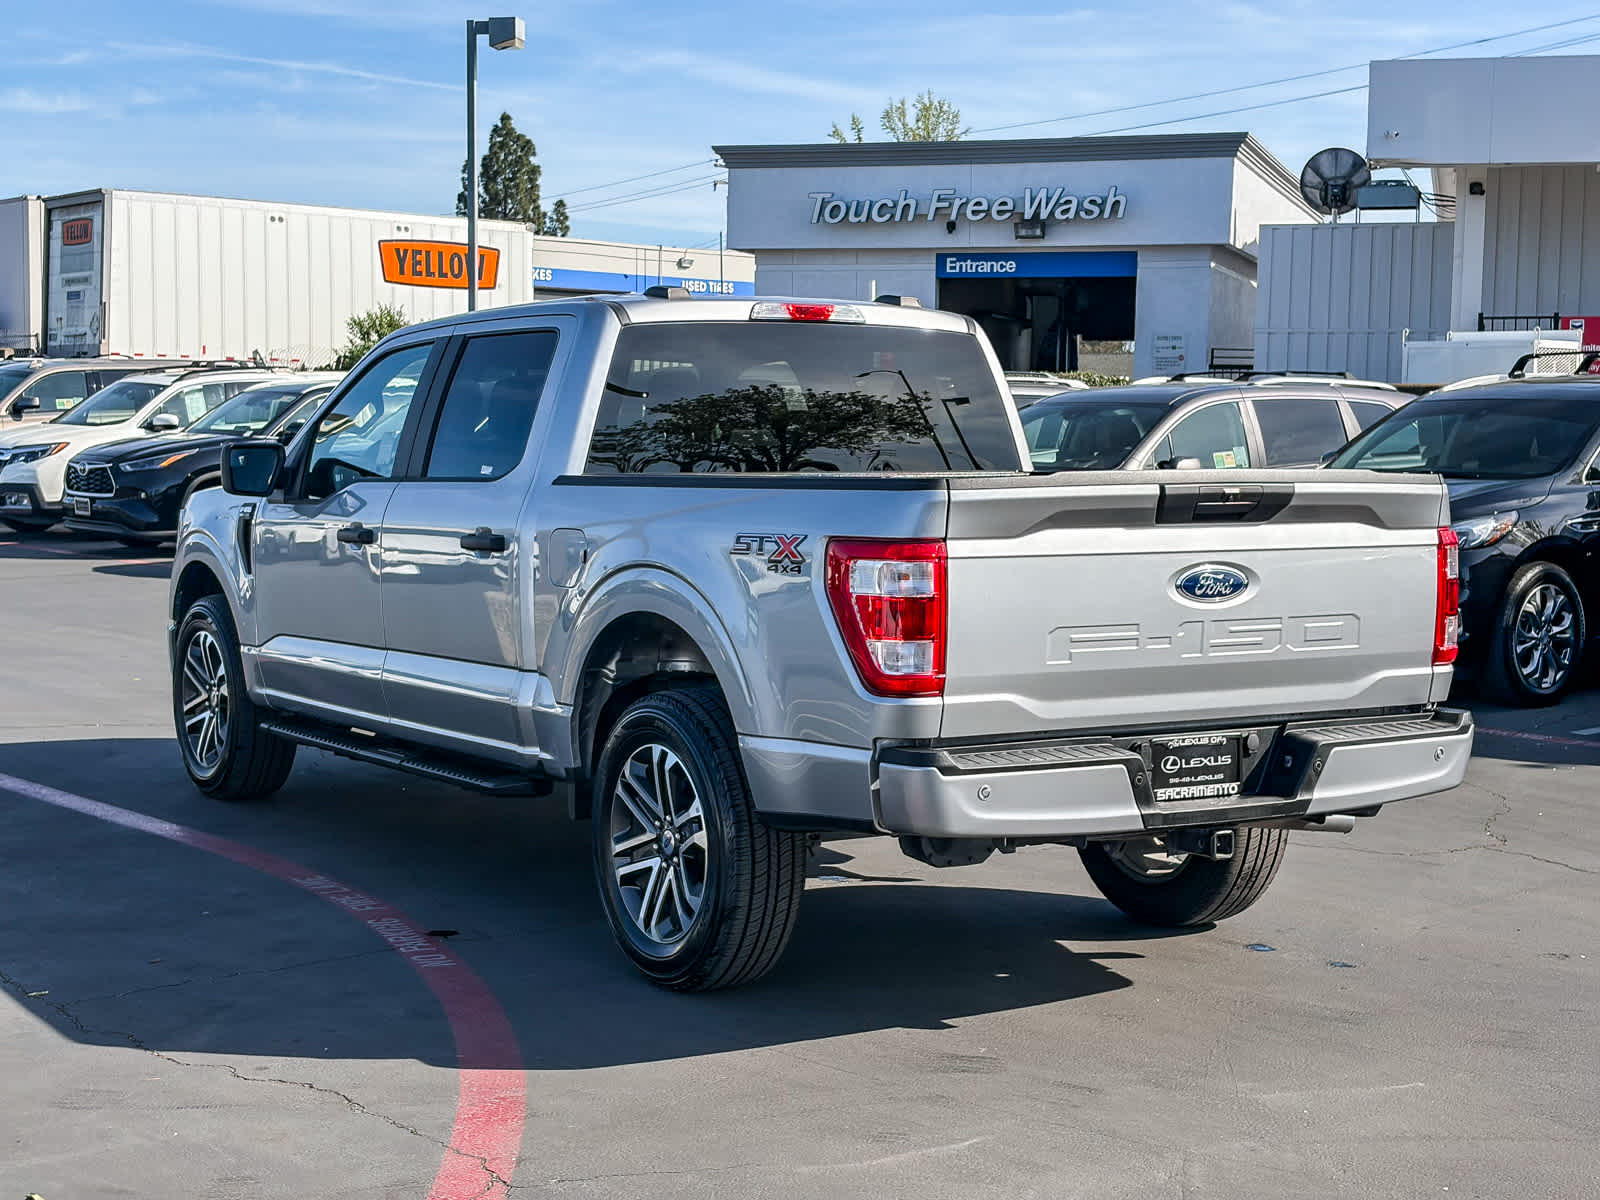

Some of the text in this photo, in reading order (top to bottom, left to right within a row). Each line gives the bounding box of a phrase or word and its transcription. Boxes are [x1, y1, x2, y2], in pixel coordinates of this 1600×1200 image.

[808, 185, 1128, 225] Touch Free Wash
[66, 222, 89, 241] YELLOW
[946, 257, 1017, 274] Entrance
[681, 280, 735, 294] USED TIRES
[730, 533, 808, 564] STX
[1195, 573, 1234, 595] Ford
[1046, 613, 1360, 664] F-150
[1180, 736, 1209, 746] LEXUS
[1182, 755, 1231, 768] LEXUS
[1156, 784, 1238, 801] SACRAMENTO
